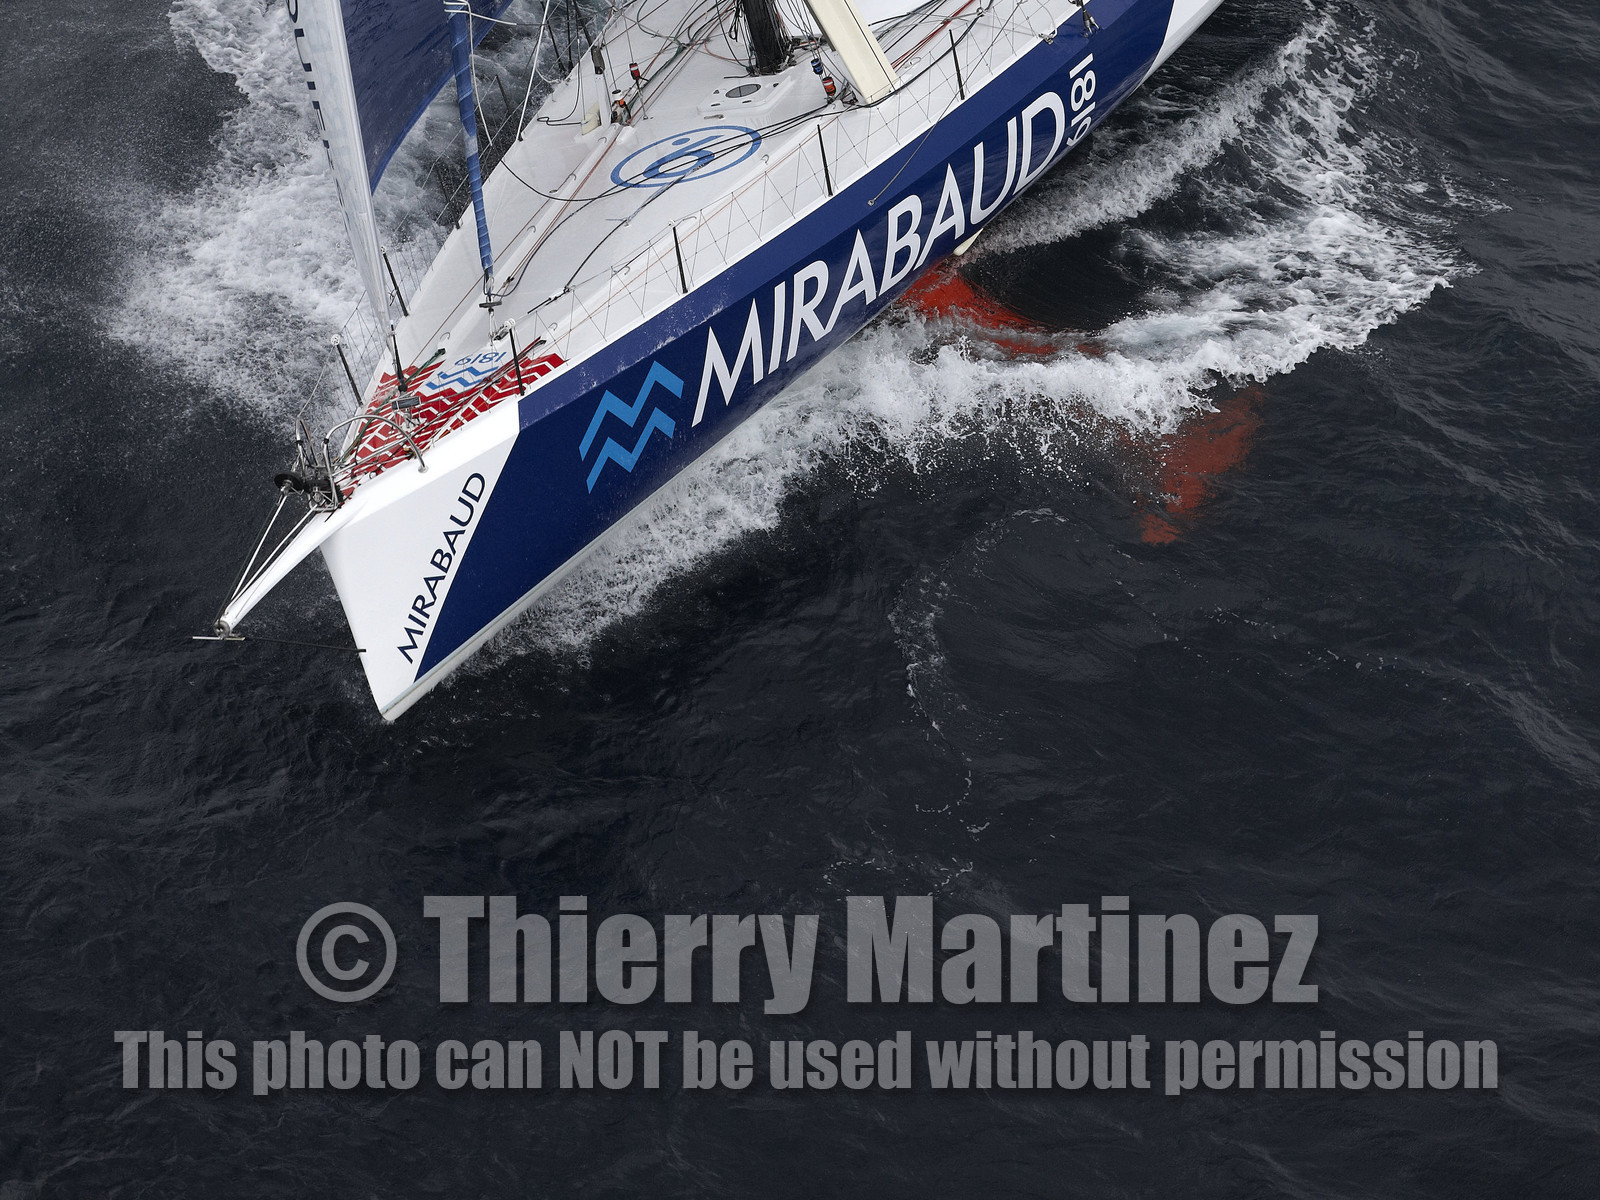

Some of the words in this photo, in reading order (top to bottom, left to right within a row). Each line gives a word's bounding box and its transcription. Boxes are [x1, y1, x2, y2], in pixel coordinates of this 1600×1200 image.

[1065, 53, 1097, 148] 1819
[691, 91, 1067, 429] MIRABAUD
[397, 472, 486, 664] MIRABAUD
